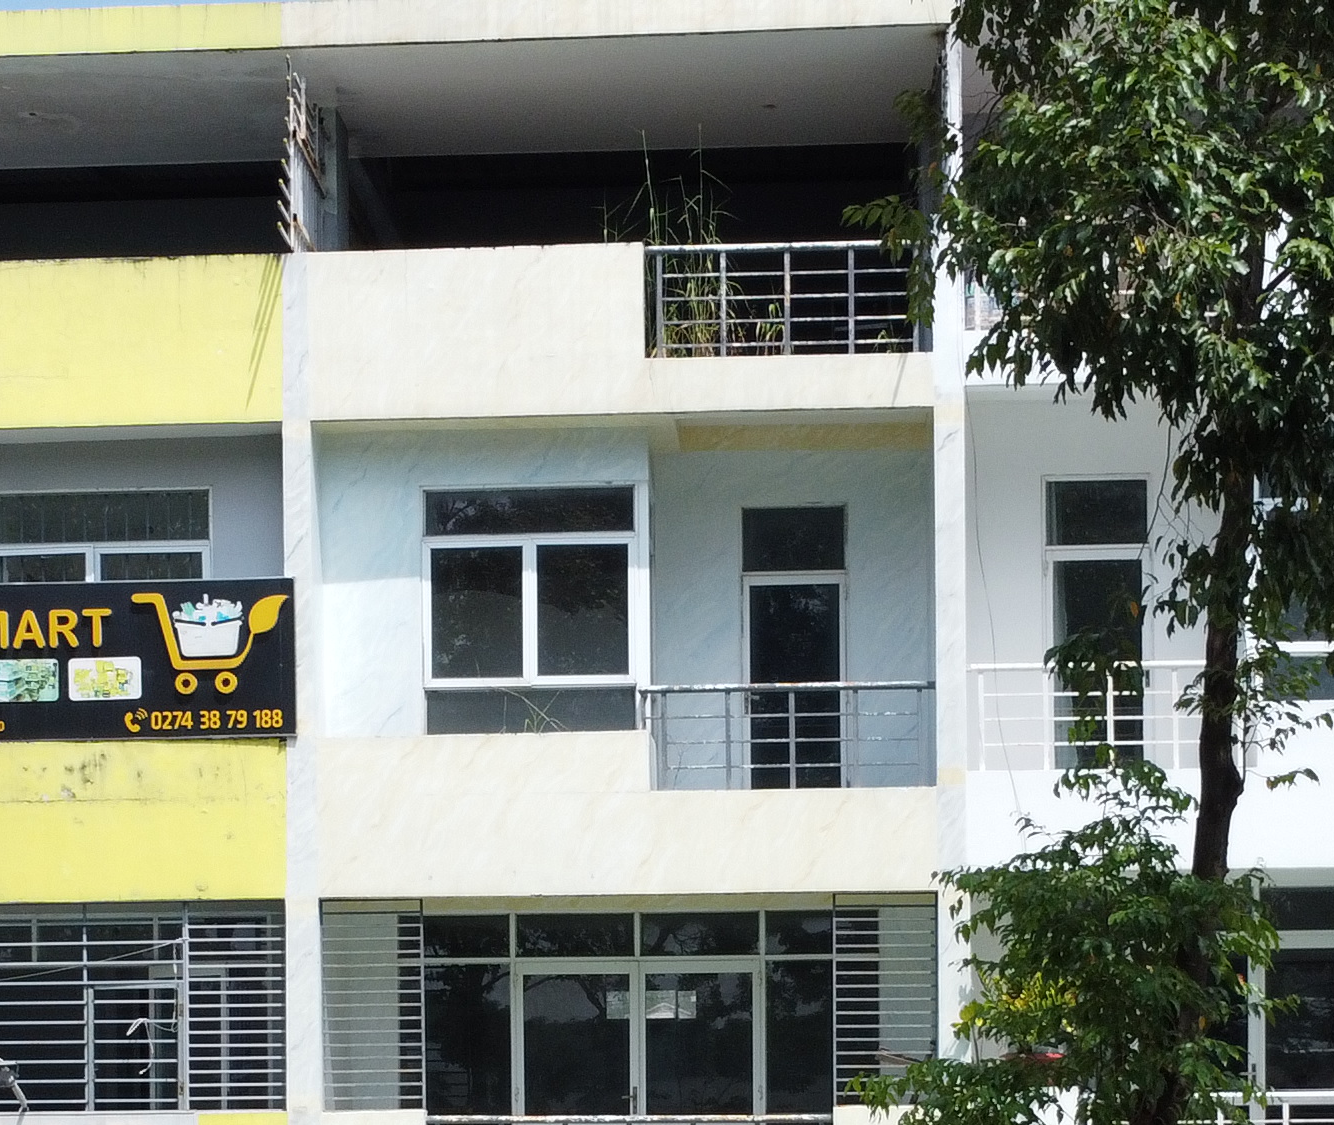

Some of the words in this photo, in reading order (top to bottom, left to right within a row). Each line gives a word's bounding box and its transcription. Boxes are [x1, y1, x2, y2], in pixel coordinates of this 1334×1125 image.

[150, 710, 194, 730] 0274
[199, 710, 221, 729] 38
[226, 709, 248, 729] 79
[252, 708, 284, 728] 188
